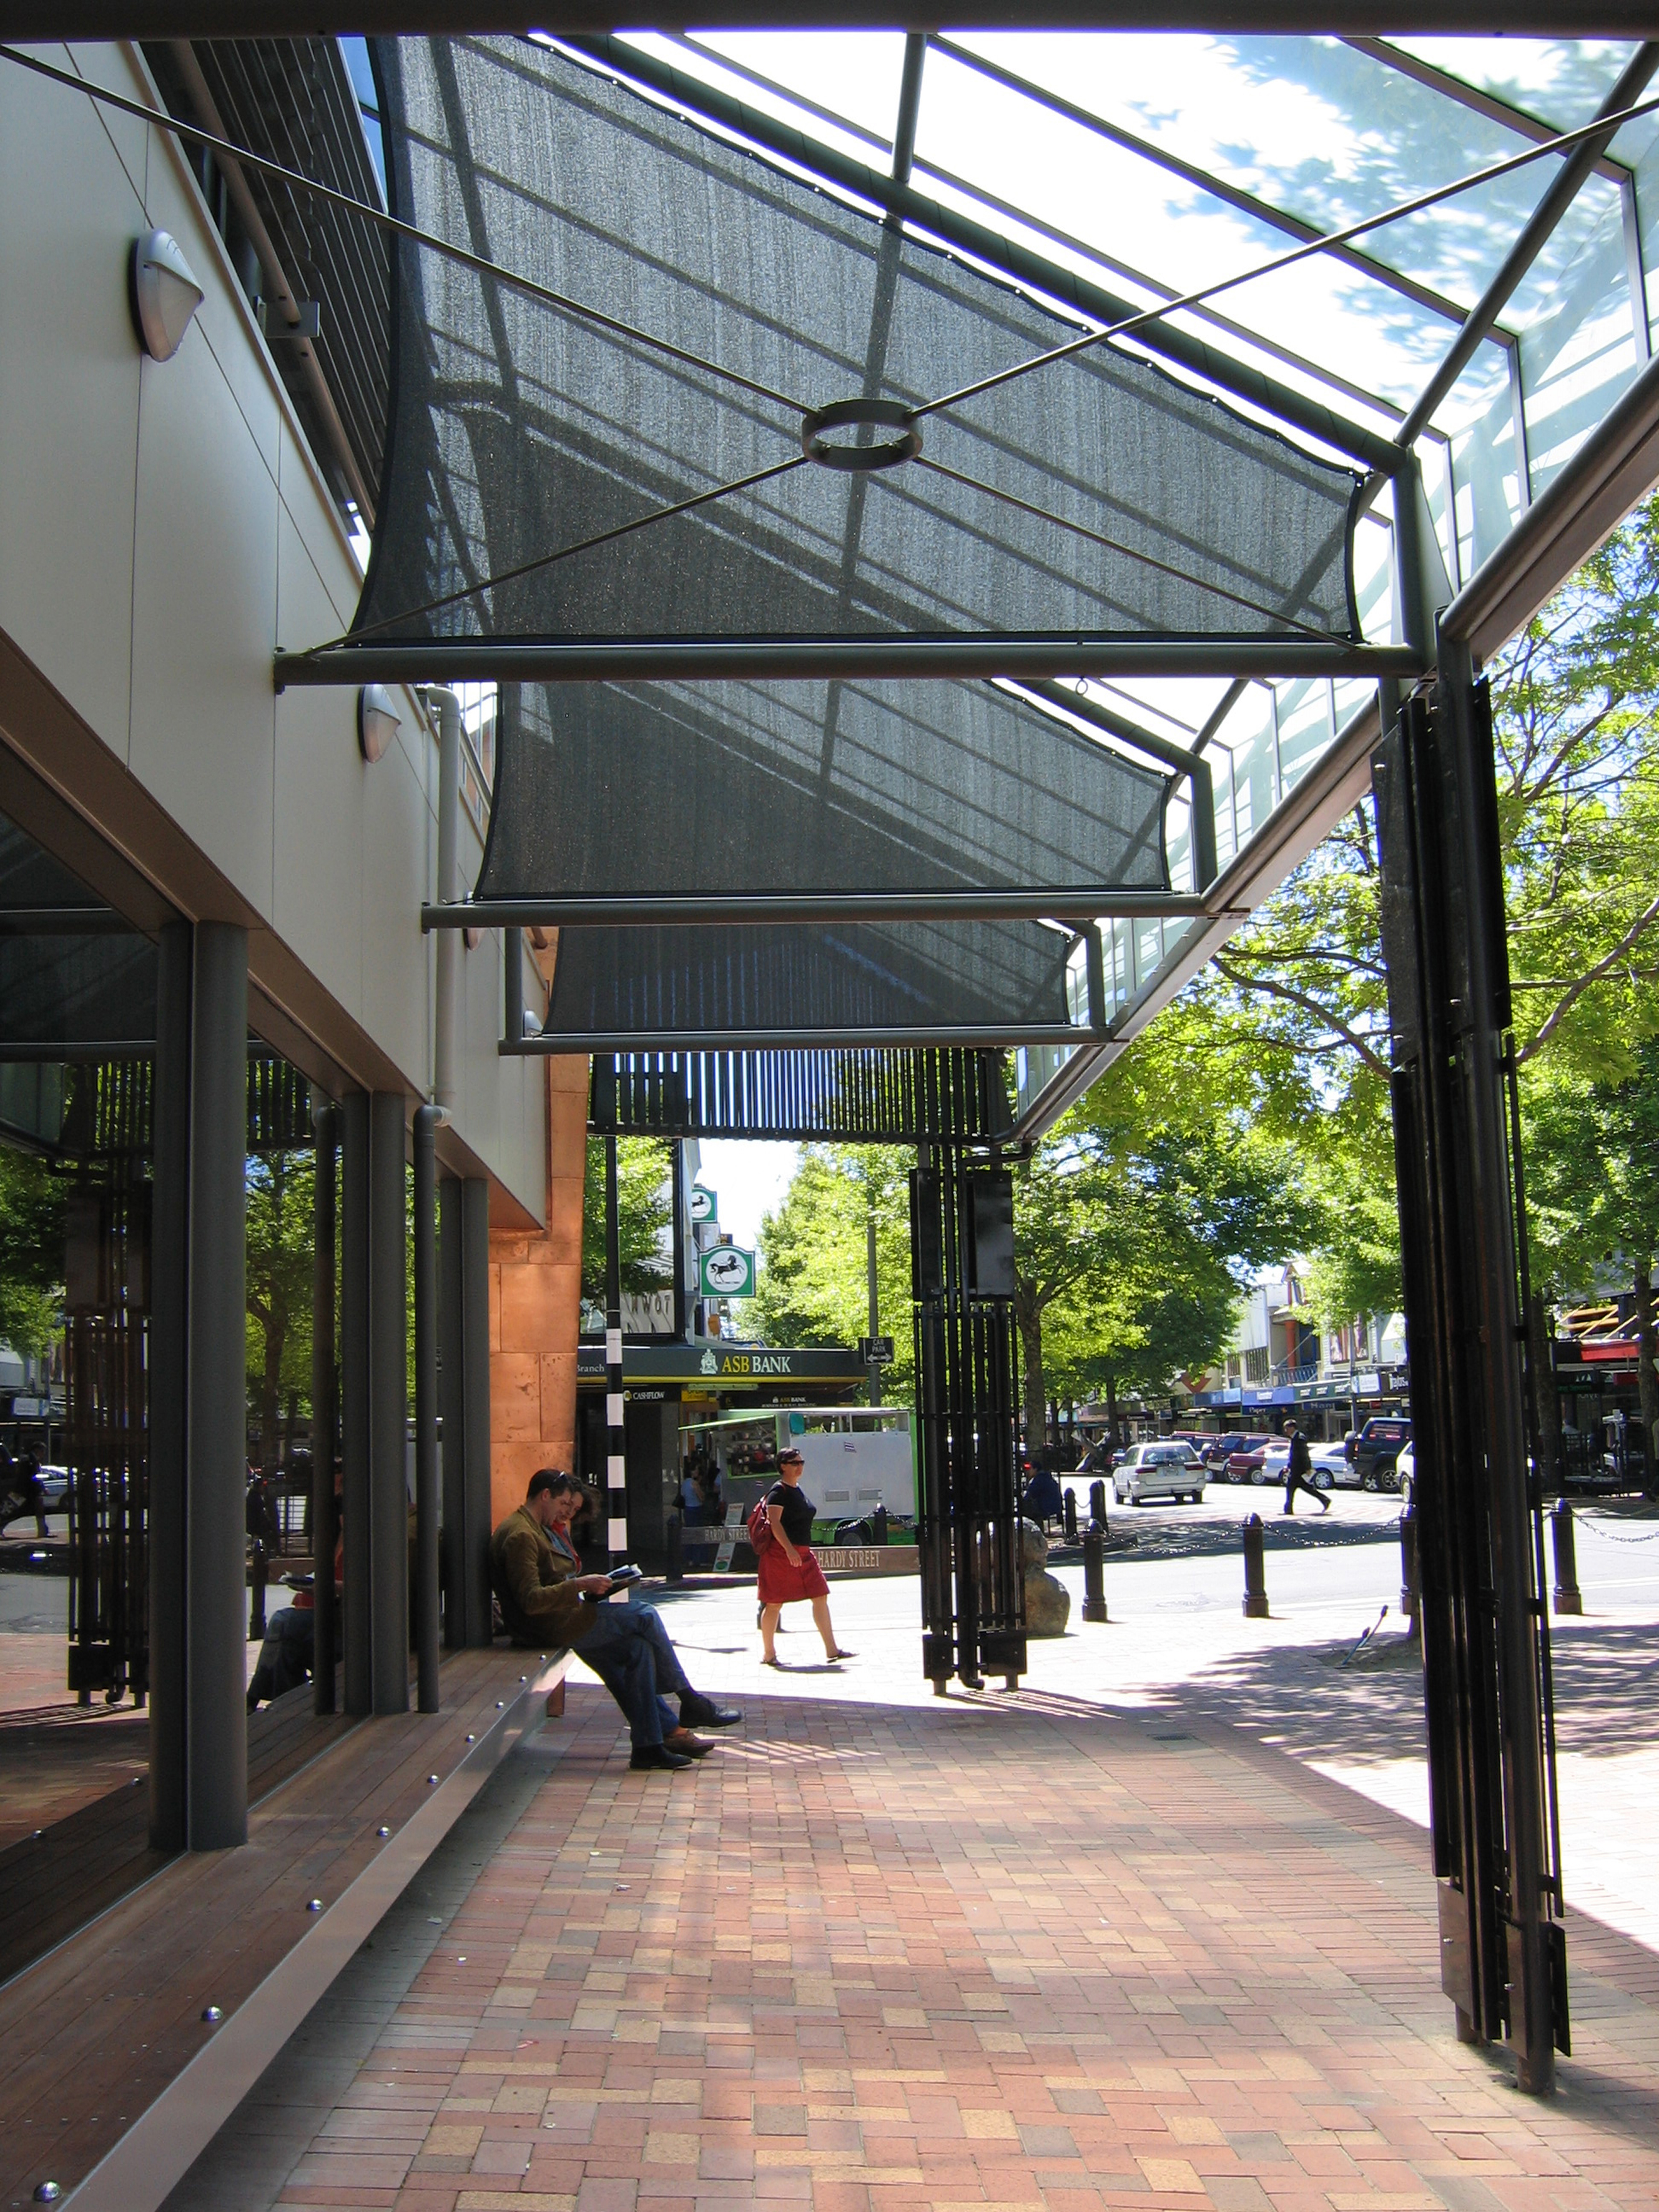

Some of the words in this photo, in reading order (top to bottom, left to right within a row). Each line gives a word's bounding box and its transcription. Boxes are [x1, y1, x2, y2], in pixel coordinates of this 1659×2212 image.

[722, 1355, 749, 1372] ASB
[752, 1356, 791, 1373] BANK
[633, 1392, 665, 1400] CASHFLOW
[704, 1529, 726, 1541] HARDY
[818, 1551, 847, 1568] HARDY
[849, 1550, 880, 1568] STREET
